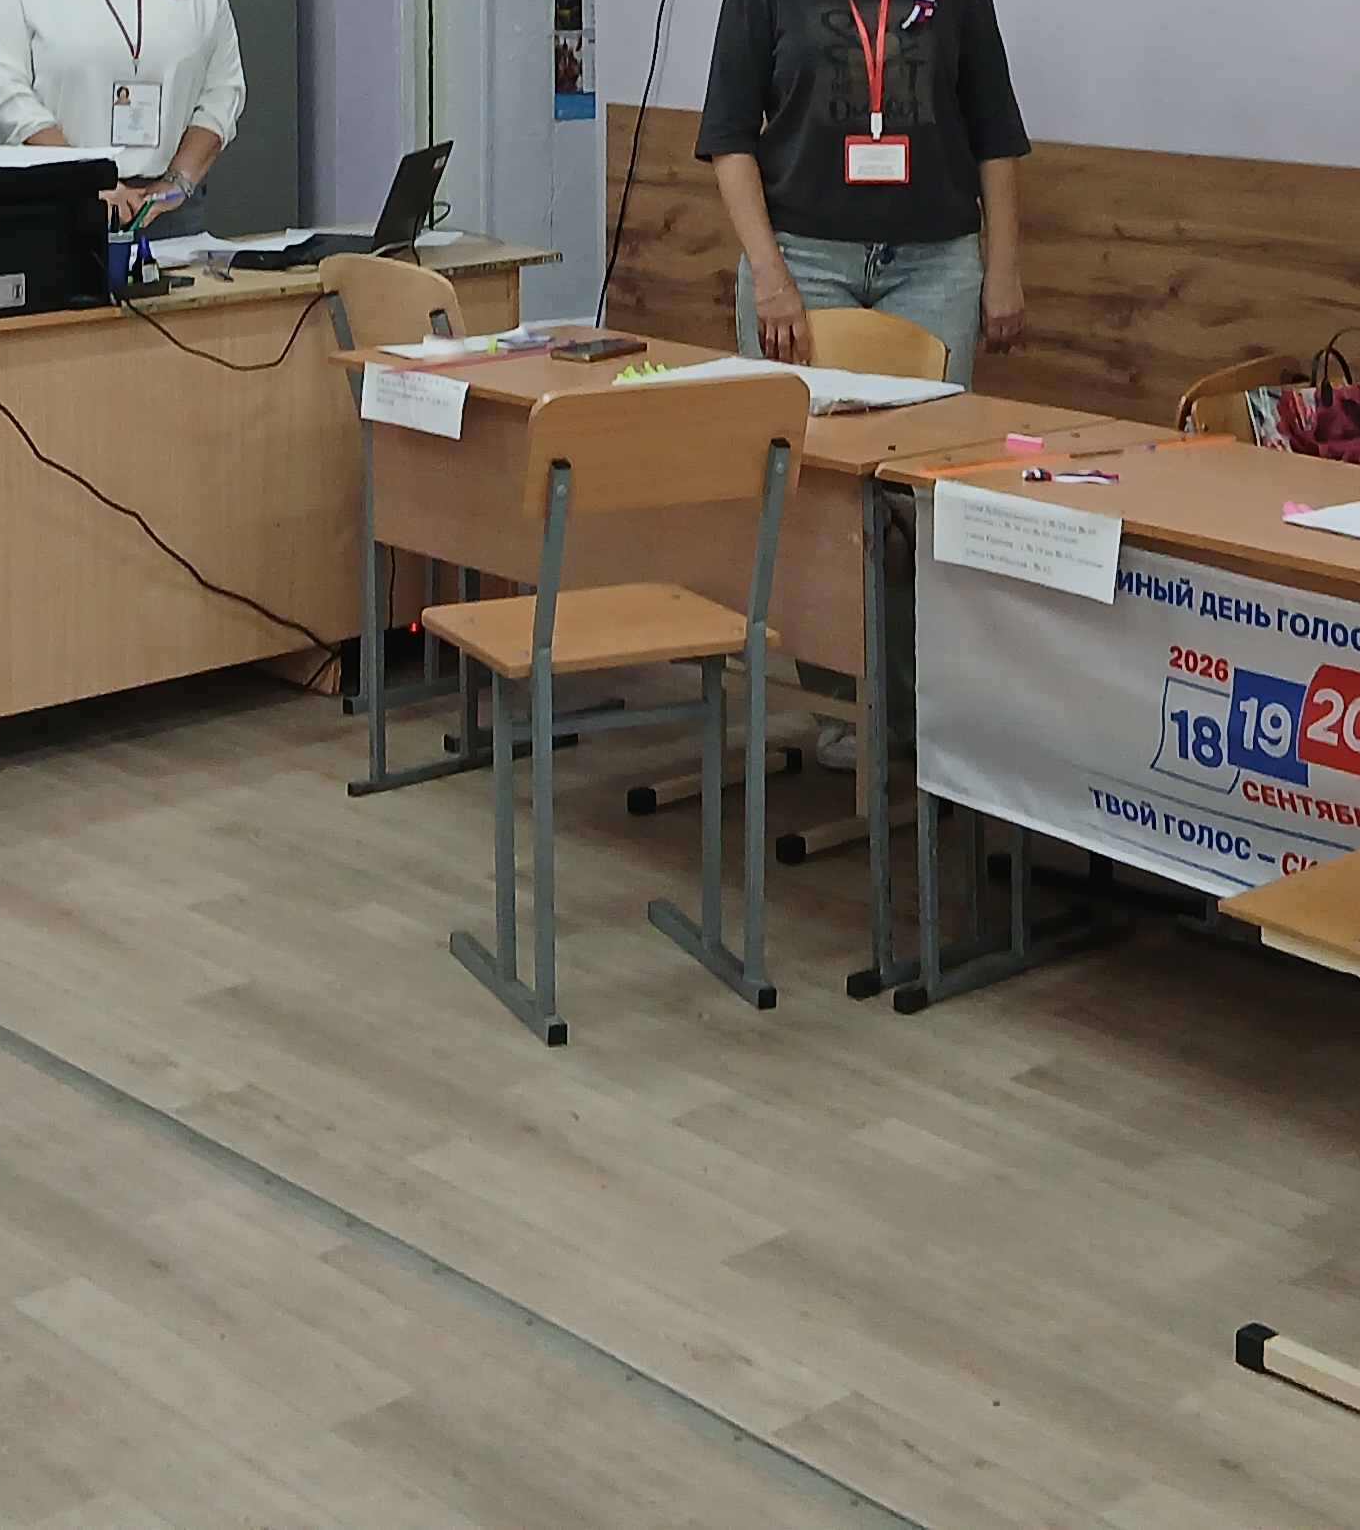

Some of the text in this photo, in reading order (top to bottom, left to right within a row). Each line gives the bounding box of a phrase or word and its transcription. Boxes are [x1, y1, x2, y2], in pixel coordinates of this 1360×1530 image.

[1116, 570, 1194, 608] ИНЫЙ
[1199, 590, 1271, 628] ДЕНЬ
[1168, 645, 1229, 682] 2026
[1170, 709, 1223, 768] 18
[1240, 697, 1292, 758] 19
[1088, 786, 1157, 831] ТВОЙ
[1163, 813, 1251, 861] ГОЛОС
